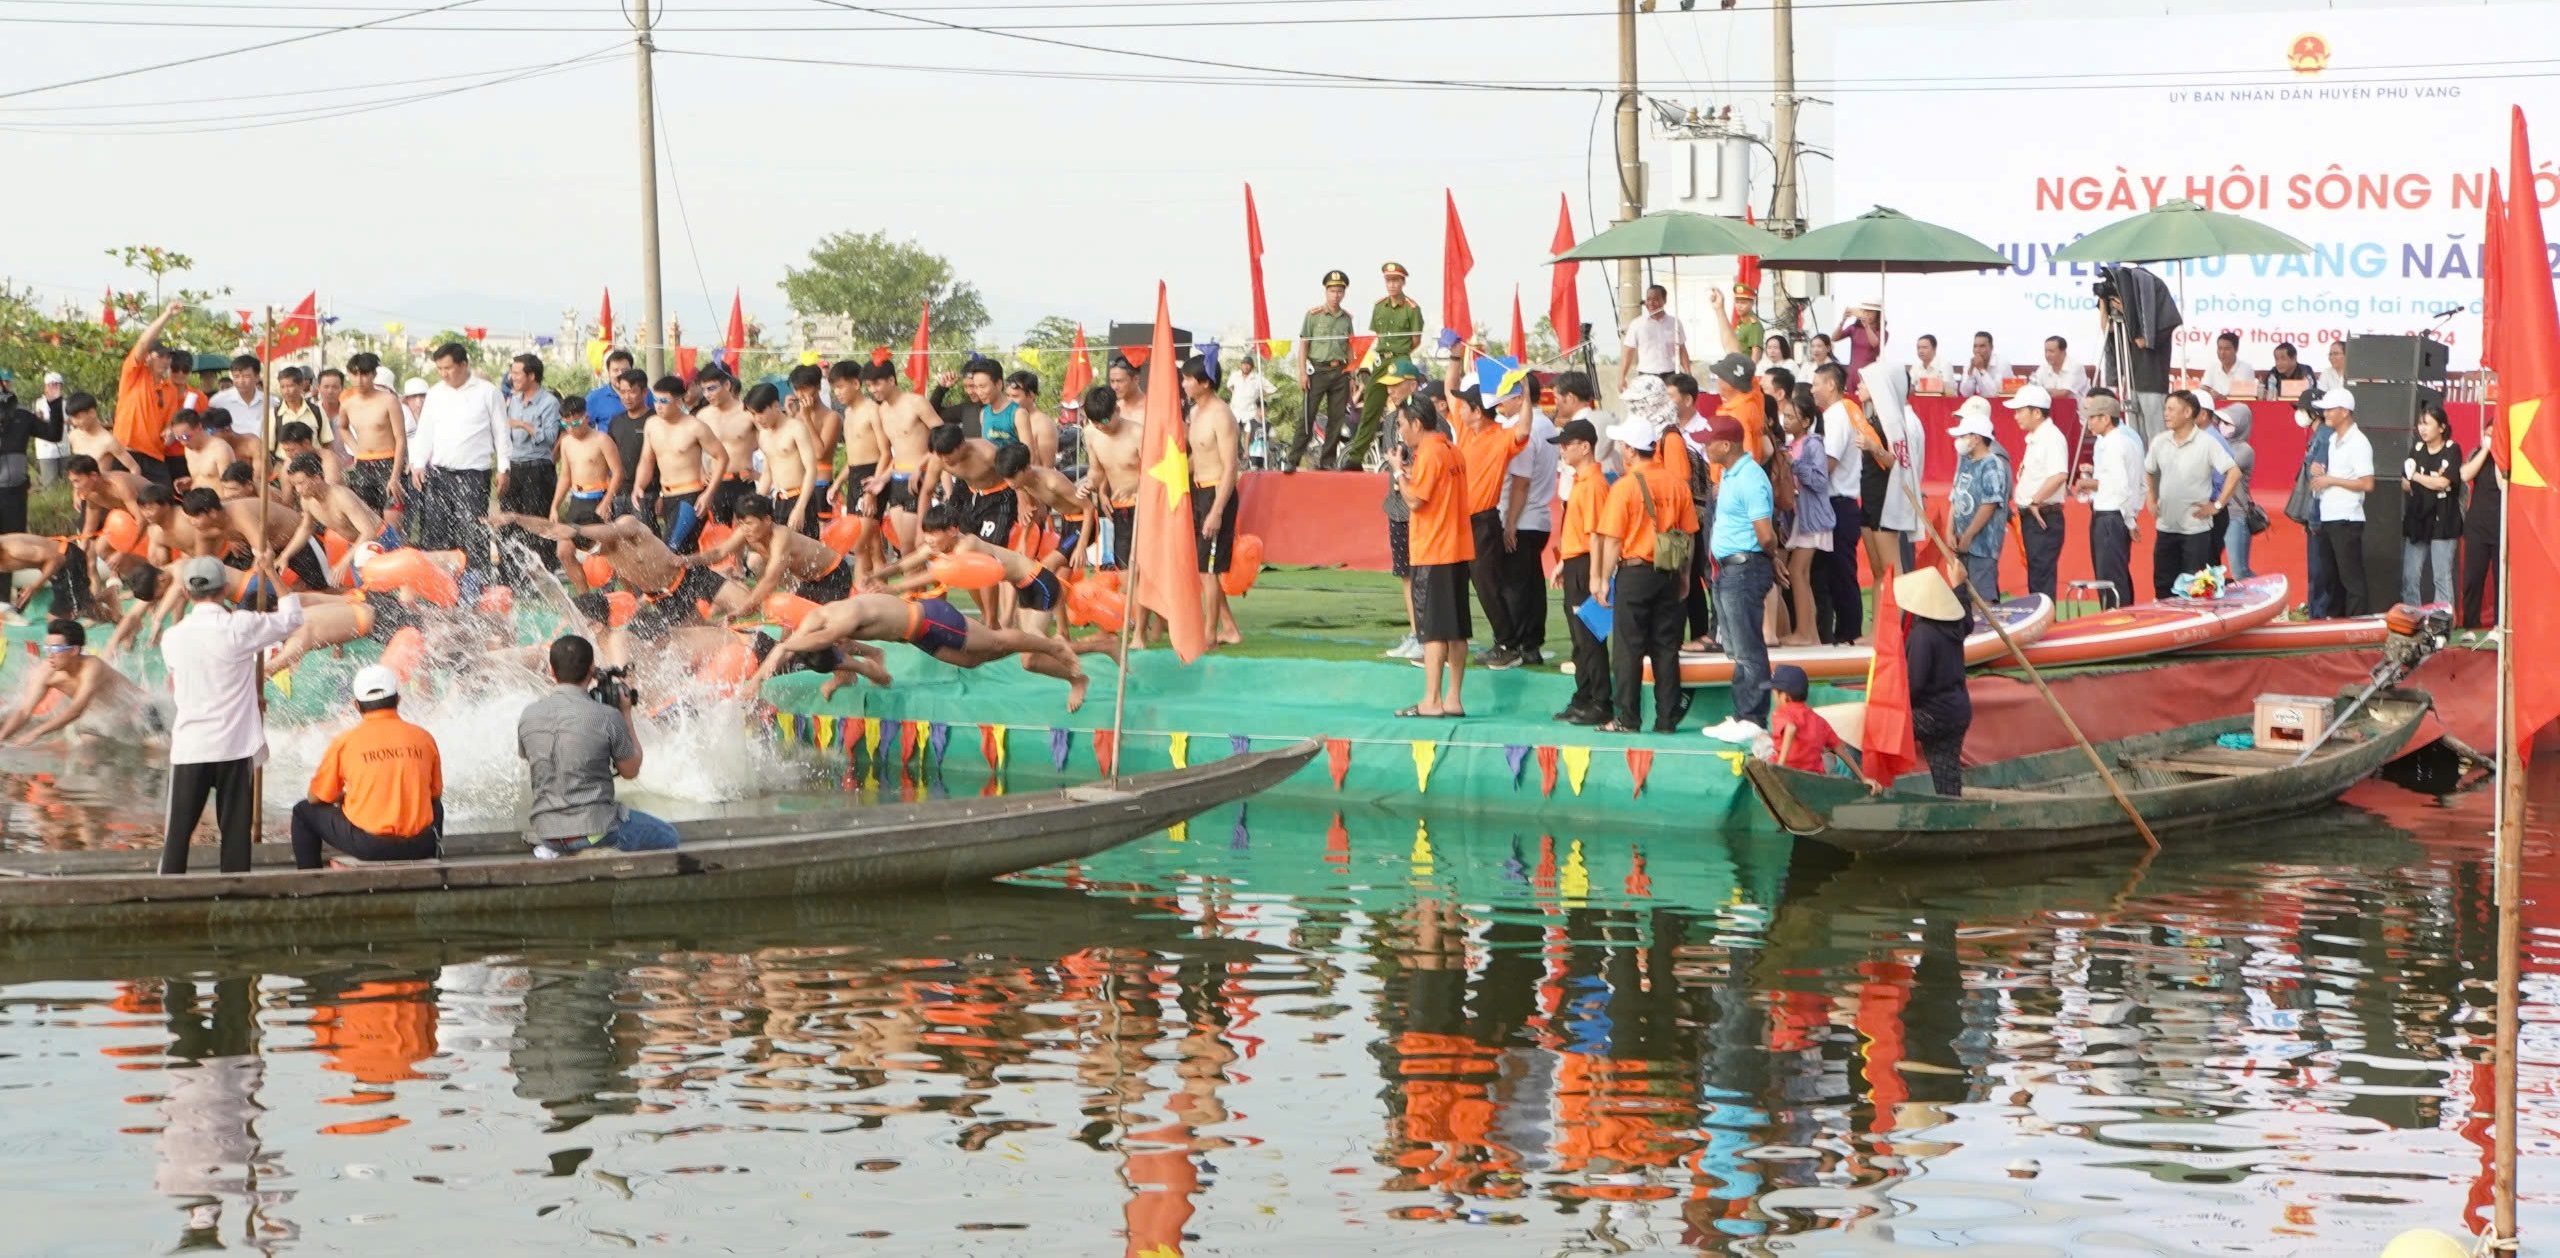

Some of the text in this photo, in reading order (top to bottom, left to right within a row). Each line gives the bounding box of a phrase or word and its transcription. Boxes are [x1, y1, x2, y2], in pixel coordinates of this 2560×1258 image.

[2194, 90, 2225, 102] BAN
[2230, 86, 2275, 102] NHÂN
[2280, 86, 2313, 101] DÂN
[2415, 86, 2461, 98] VANG
[2036, 165, 2167, 211] NGÀY
[2287, 164, 2432, 210] SÔNG
[2402, 233, 2485, 279] NĂ
[2195, 294, 2271, 316] phòng
[2281, 291, 2359, 318] chống
[2370, 296, 2401, 314] tai
[2250, 327, 2309, 348] tháng
[362, 748, 404, 763] TRỌNG
